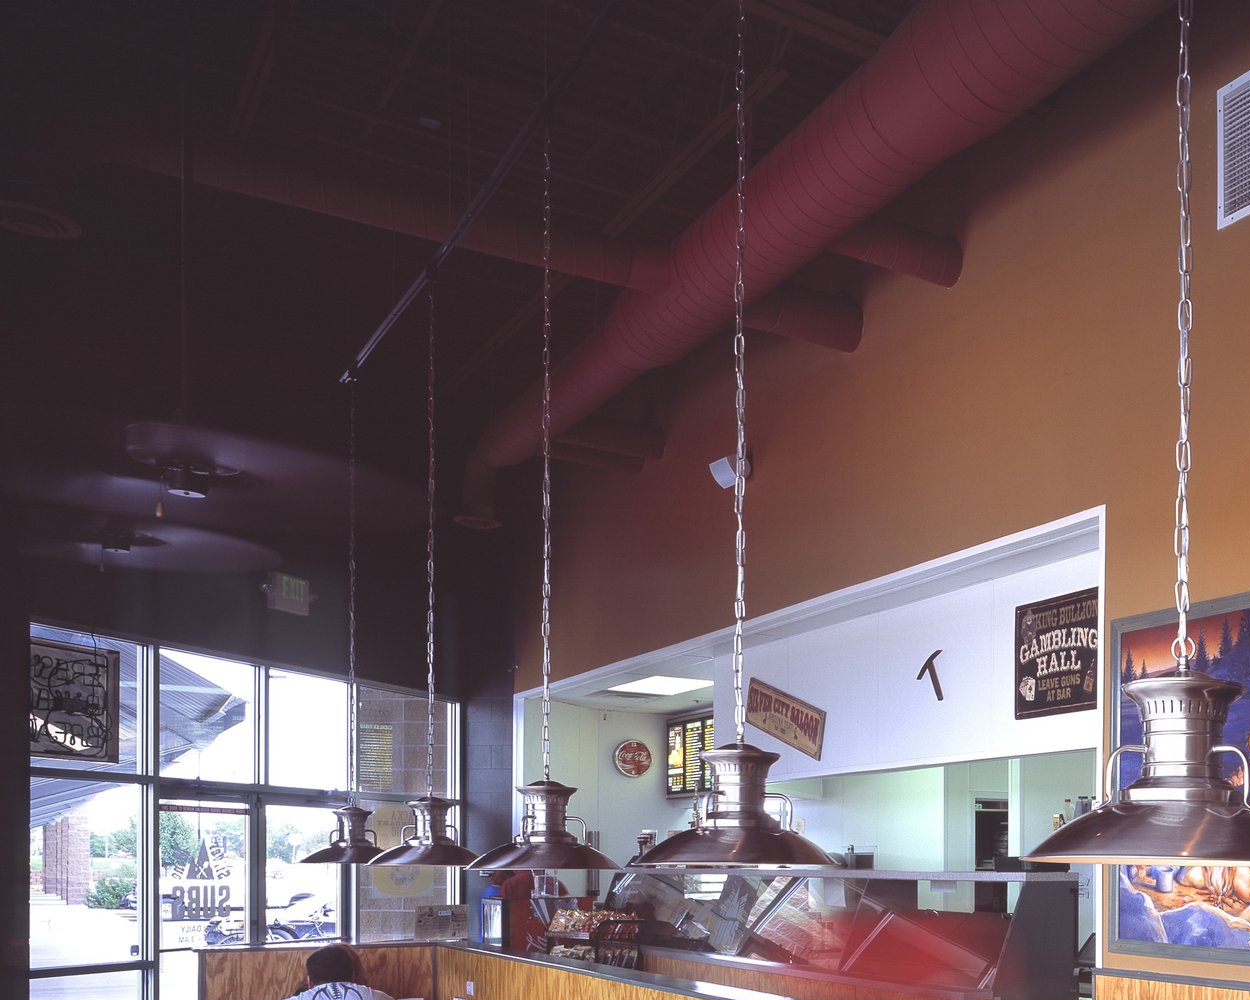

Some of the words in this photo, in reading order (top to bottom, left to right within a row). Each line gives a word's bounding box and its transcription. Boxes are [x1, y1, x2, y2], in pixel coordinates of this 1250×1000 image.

[281, 575, 306, 601] EXIT
[1035, 609, 1058, 630] KING
[1058, 599, 1099, 626] BULLION
[1019, 626, 1098, 665] GAMBLING
[1036, 650, 1082, 678] HALL
[1037, 677, 1060, 691] LEAVE
[1060, 673, 1081, 688] GUNS
[1046, 690, 1055, 702] AT
[1056, 687, 1072, 701] BAR
[773, 697, 791, 719] CITY
[790, 706, 820, 747] SALOON
